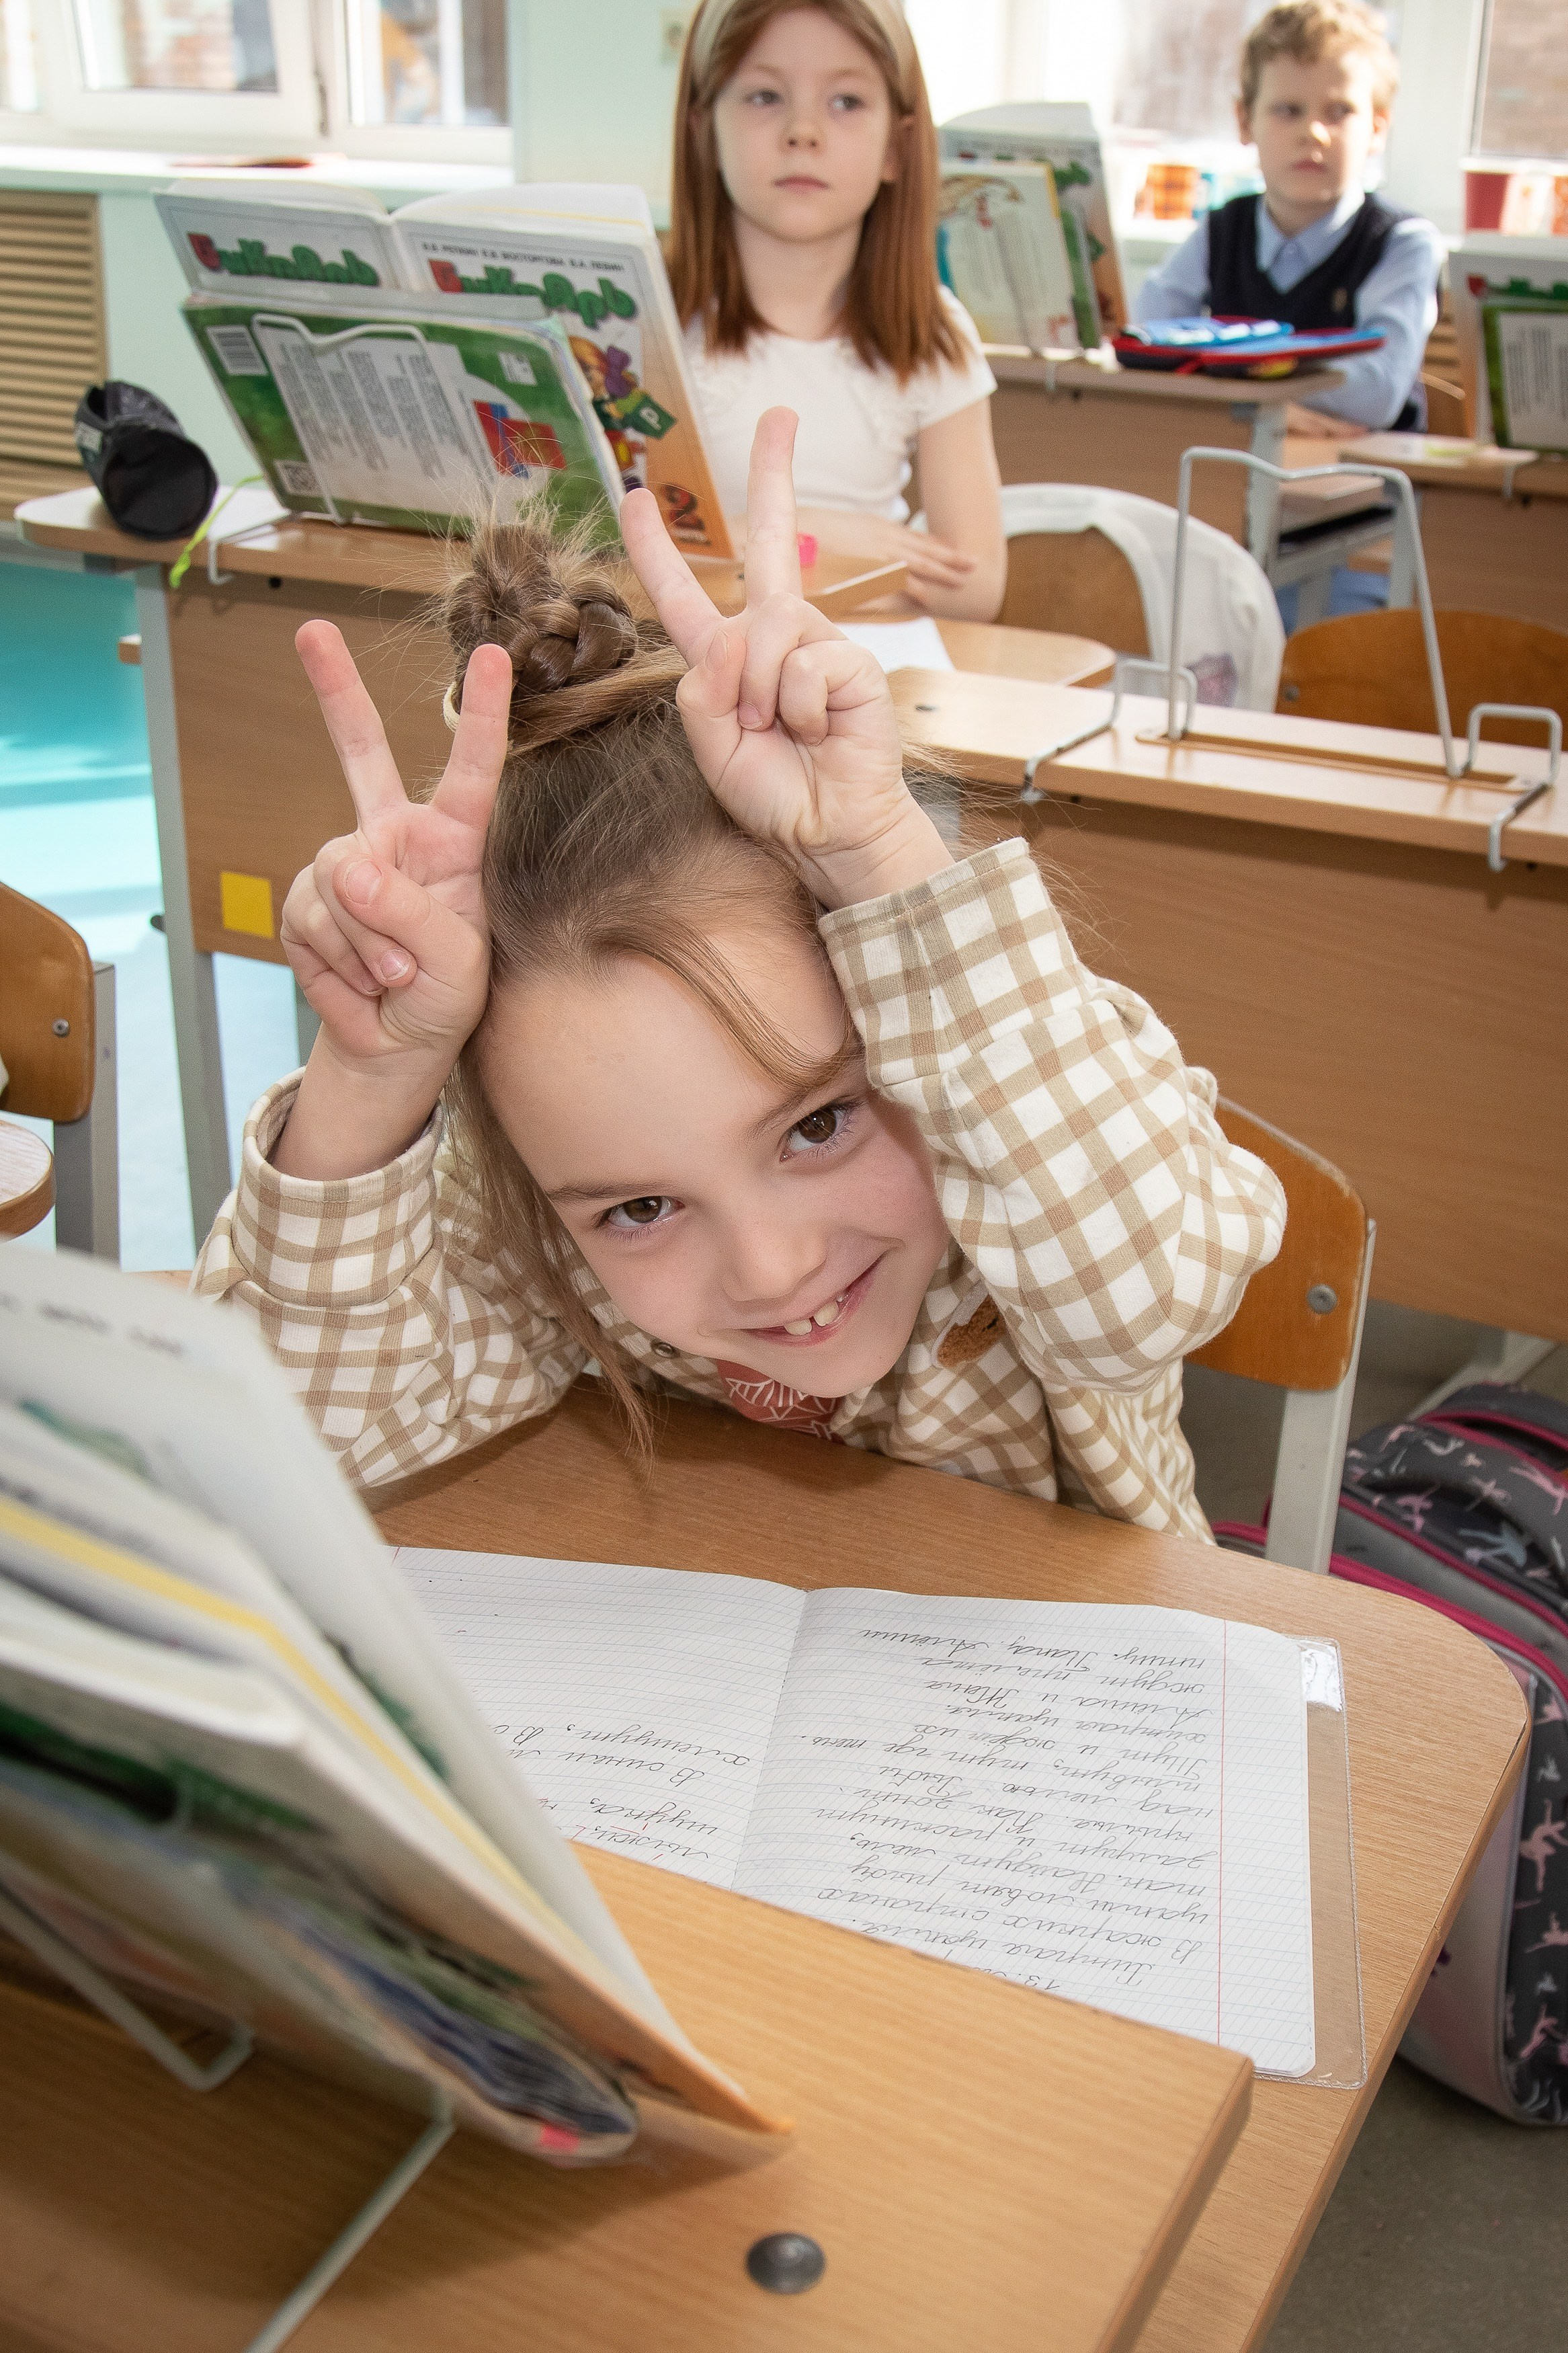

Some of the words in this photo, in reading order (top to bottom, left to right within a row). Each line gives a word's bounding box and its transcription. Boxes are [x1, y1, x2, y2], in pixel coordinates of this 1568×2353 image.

[1095, 1669, 1204, 1693] ждут
[923, 1680, 1019, 1708] Женя
[1036, 1693, 1058, 1703] и
[511, 1725, 544, 1745] В
[1076, 1744, 1098, 1755] и
[1114, 1741, 1206, 1780] Тут
[669, 1767, 704, 1787] В
[1130, 1788, 1213, 1817] над
[1013, 1835, 1035, 1846] и
[846, 1854, 948, 1886] рыбу
[1171, 1939, 1202, 1964] В
